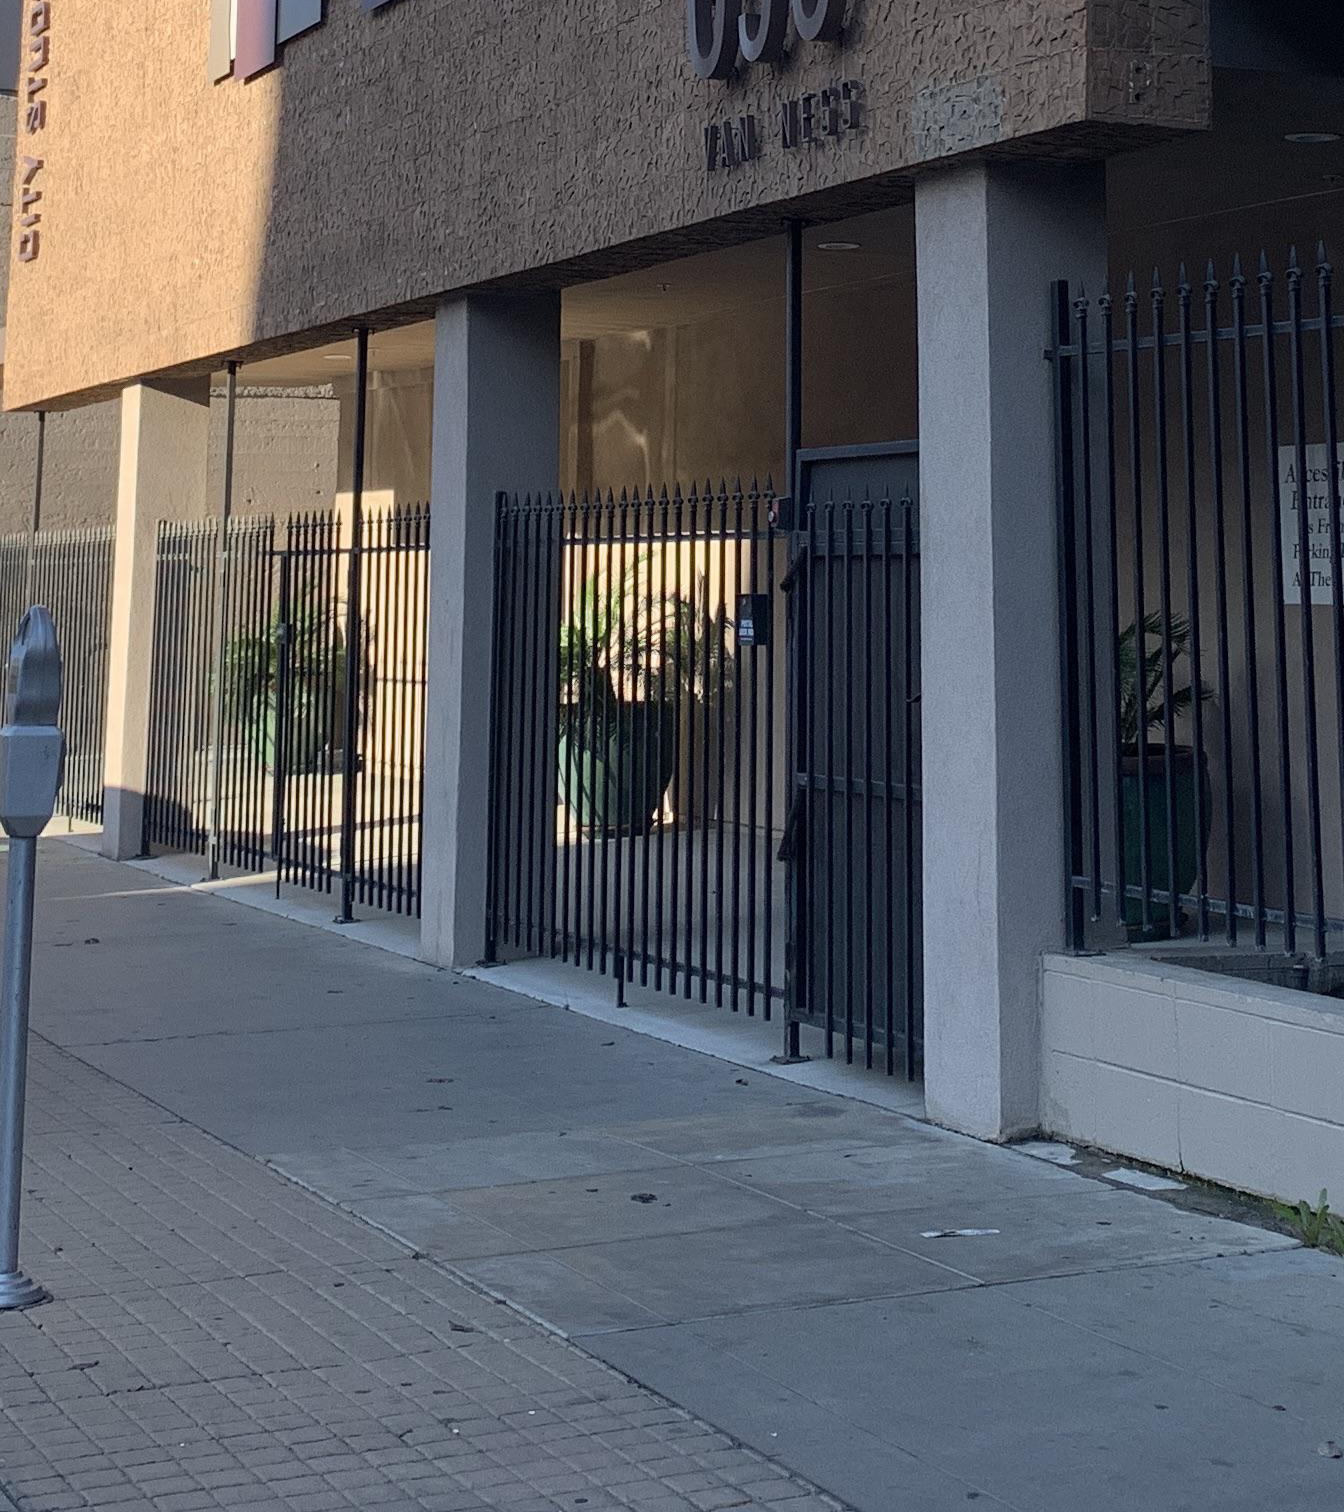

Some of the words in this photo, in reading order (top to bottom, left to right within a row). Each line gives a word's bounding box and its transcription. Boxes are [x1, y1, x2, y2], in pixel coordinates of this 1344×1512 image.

[704, 113, 758, 172] VAN
[780, 78, 862, 150] NESS
[18, 155, 45, 263] CITY
[1310, 571, 1332, 587] The
